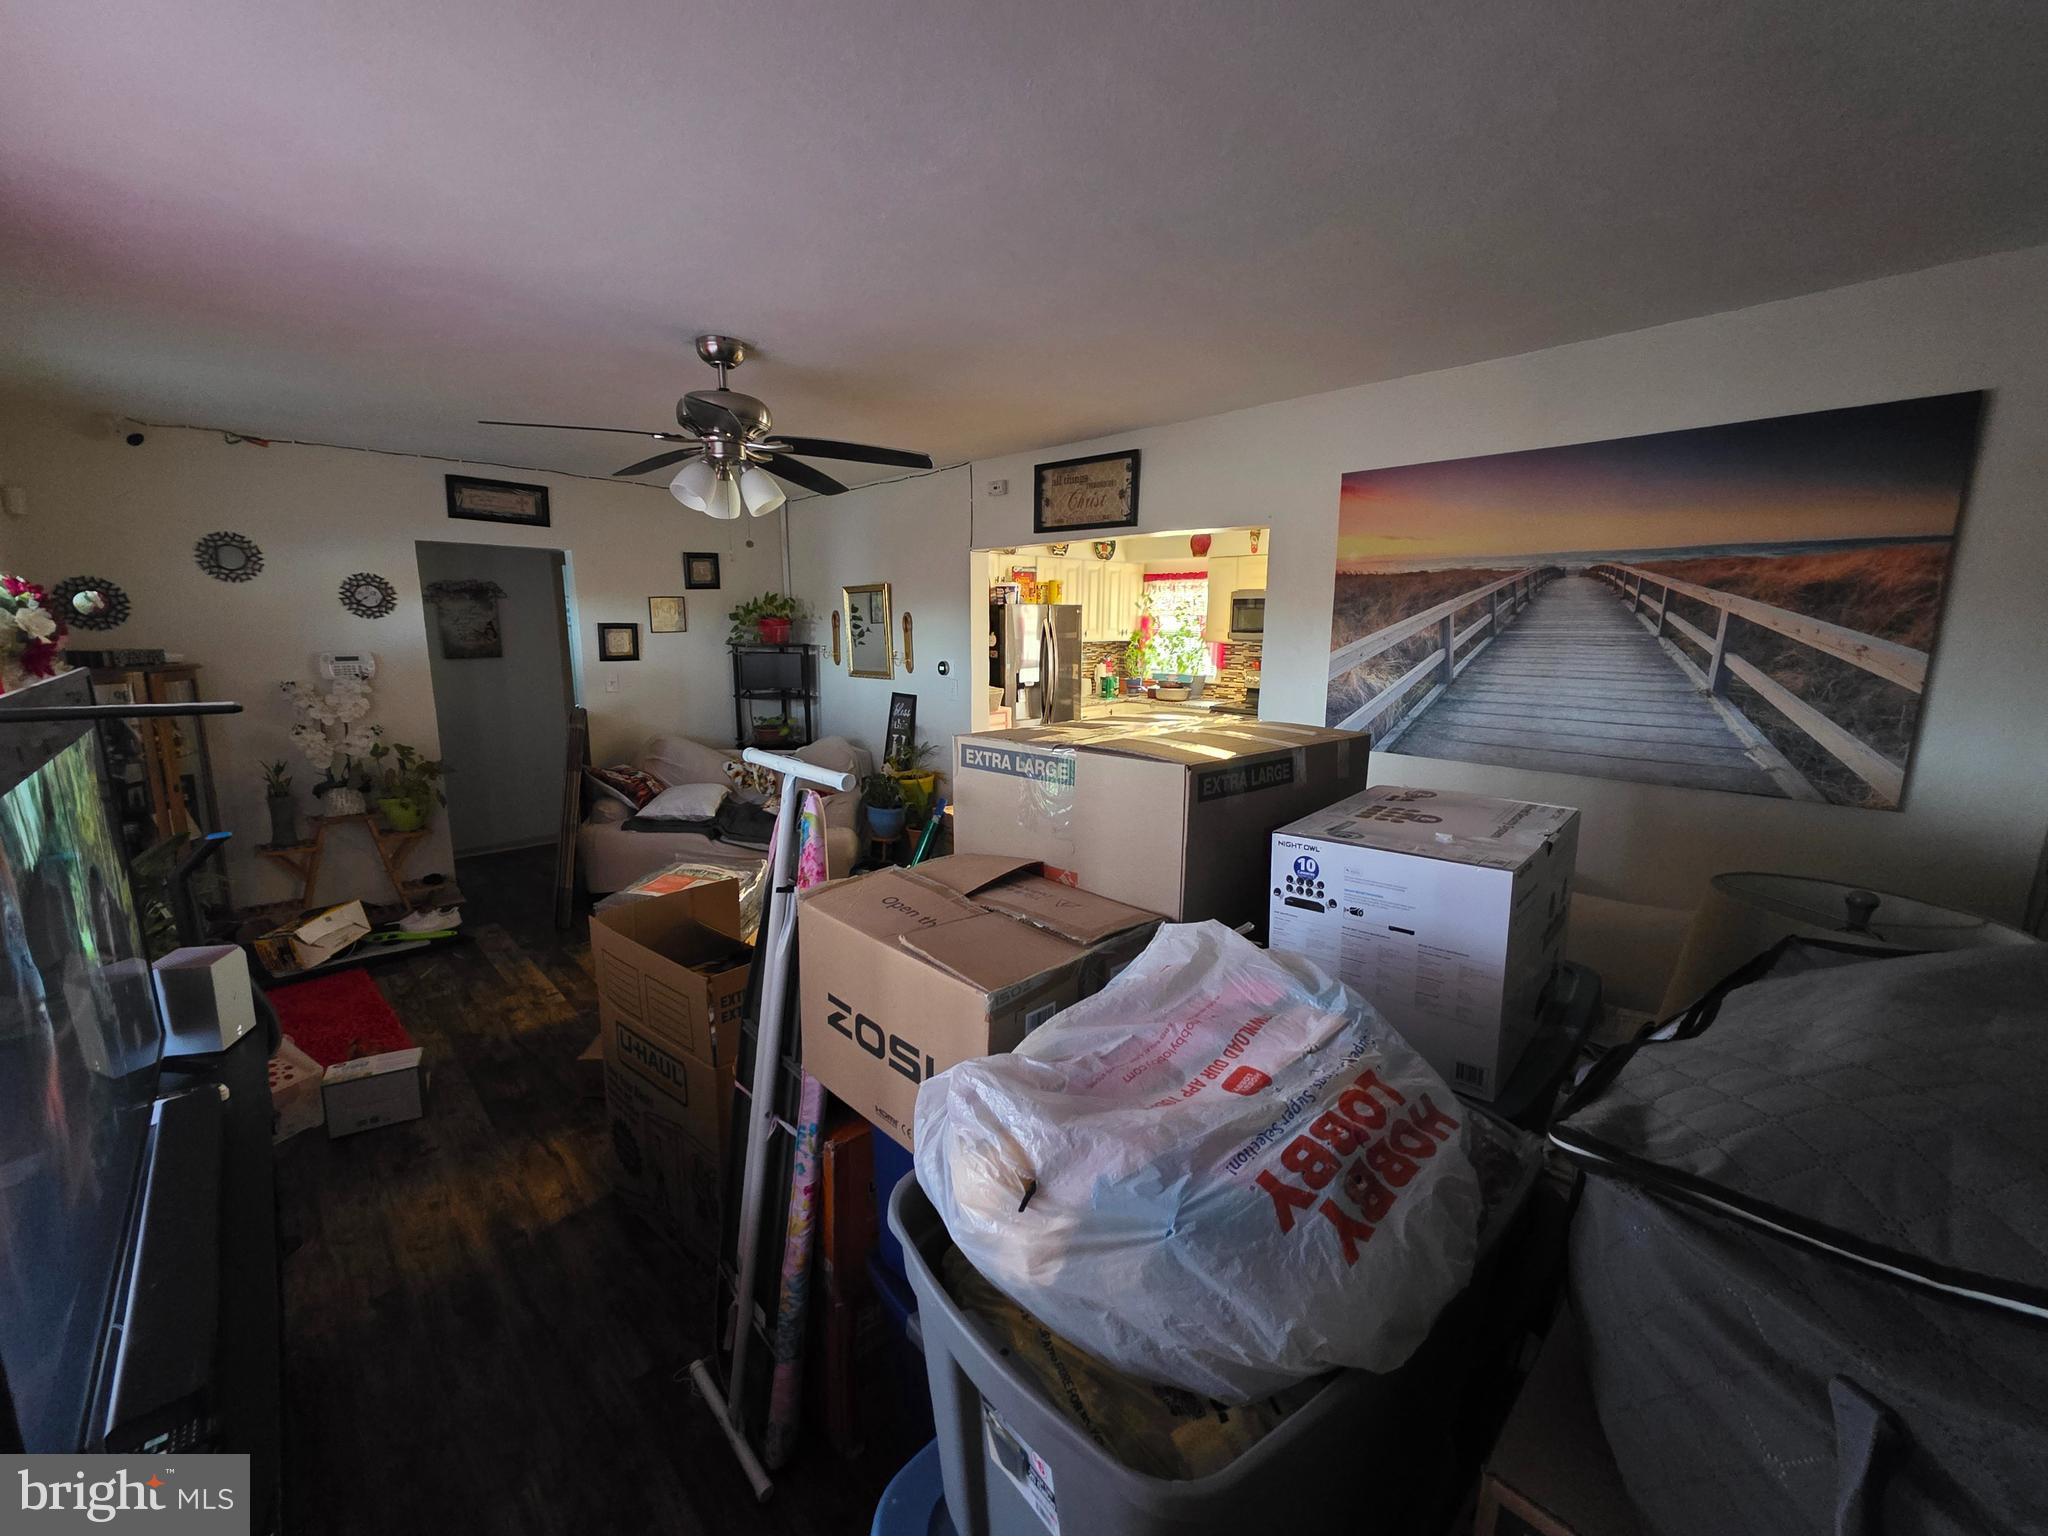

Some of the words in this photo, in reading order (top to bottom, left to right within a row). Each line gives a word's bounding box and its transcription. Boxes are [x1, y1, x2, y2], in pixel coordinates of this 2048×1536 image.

[1067, 488, 1106, 511] Christ
[965, 748, 1012, 770] EXTRA
[1015, 757, 1070, 778] LARGE
[1202, 771, 1248, 796] EXTRA
[1251, 762, 1291, 786] LARGE
[1278, 840, 1303, 850] NIGHT
[1303, 844, 1321, 853] OWL
[1297, 857, 1316, 873] 10
[881, 895, 920, 919] Open
[827, 992, 935, 1085] ZOSI
[1222, 1015, 1273, 1059] WNLOAD
[620, 1028, 683, 1088] U-HAUL
[1200, 1058, 1229, 1081] OUR
[1179, 1078, 1207, 1098] APP
[1283, 1089, 1317, 1124] Super
[1225, 1121, 1285, 1177] Selection!
[1254, 1068, 1407, 1236] LOBBY
[1318, 1092, 1460, 1268] HOBBY
